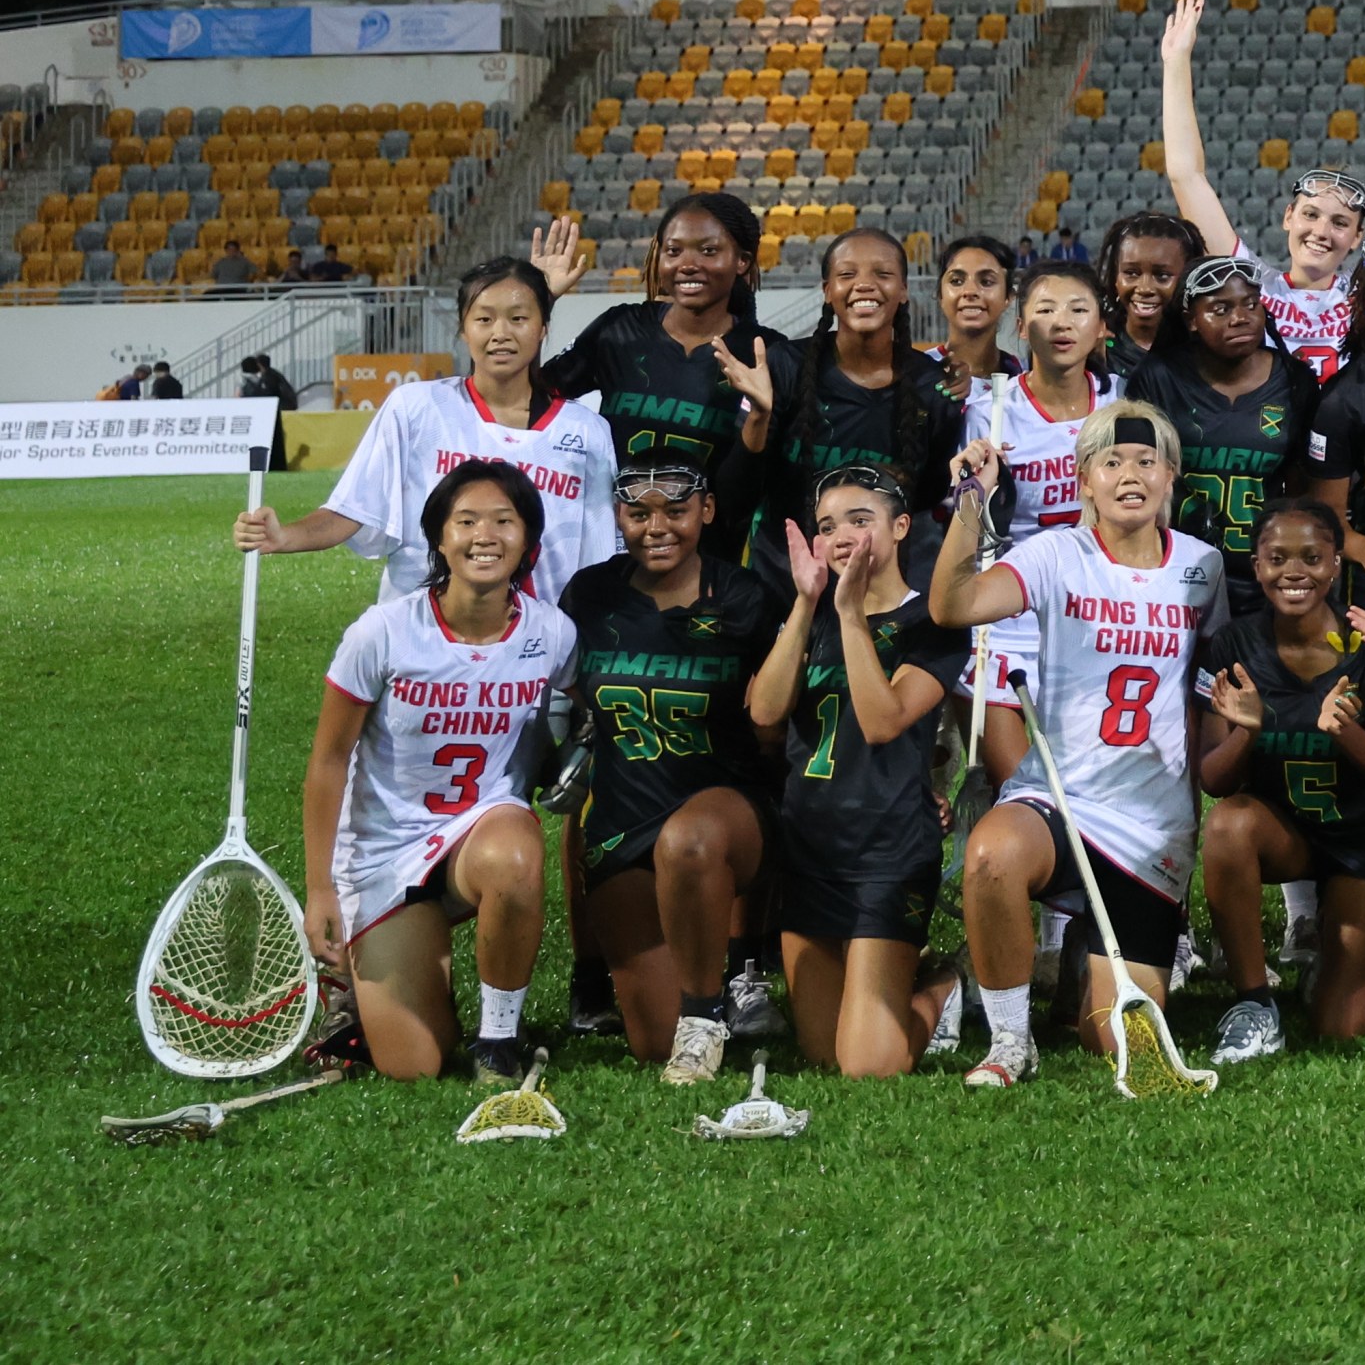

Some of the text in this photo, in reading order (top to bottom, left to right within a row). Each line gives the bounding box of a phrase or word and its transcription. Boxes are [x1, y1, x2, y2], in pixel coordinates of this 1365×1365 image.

[1259, 294, 1313, 330] HONG
[339, 367, 377, 383] BOCK
[602, 392, 742, 434] JAMAIC
[27, 444, 86, 462] Sports
[92, 442, 149, 458] Events
[155, 441, 250, 457] Committee
[436, 449, 505, 475] HO
[1064, 591, 1203, 631] HONG KON
[1095, 627, 1180, 659] CHINA
[393, 677, 469, 708] HONG
[1099, 663, 1161, 747] 8
[421, 711, 510, 735] CHINA
[595, 684, 713, 762] 35
[804, 693, 840, 780] 1
[423, 743, 489, 815] 3
[1284, 760, 1343, 823] 5
